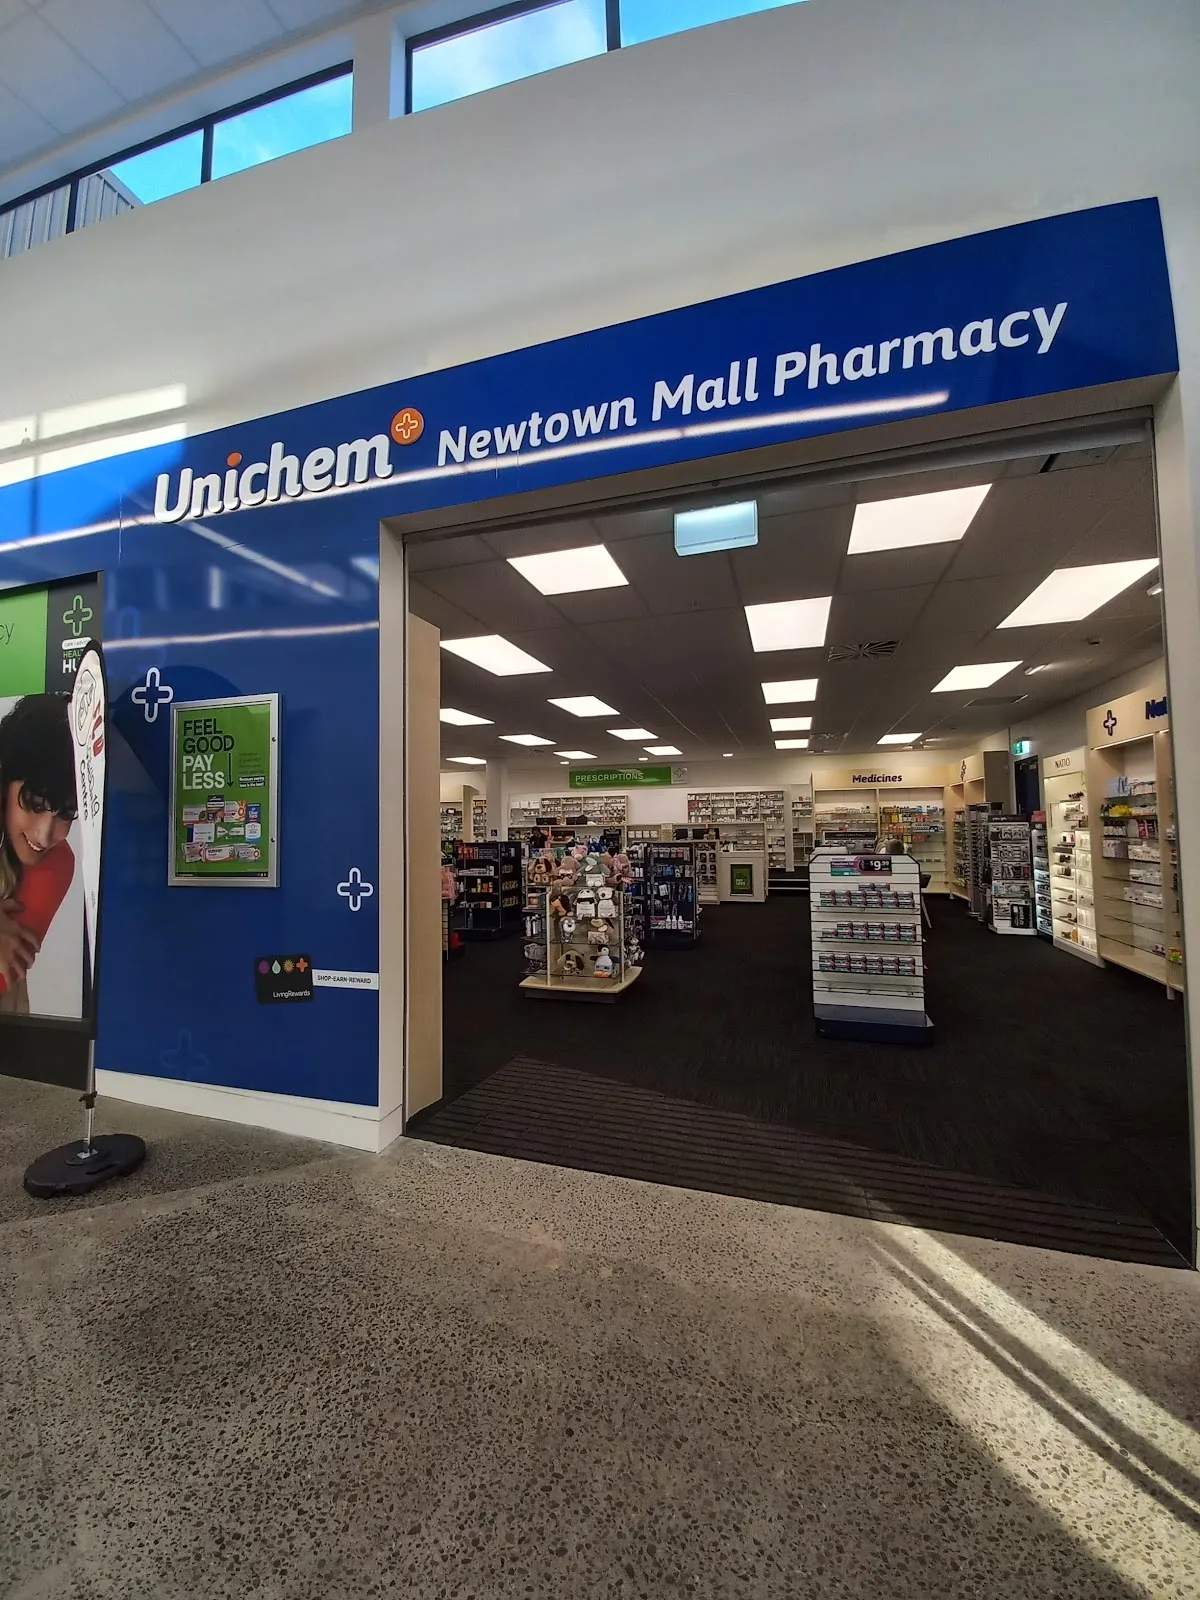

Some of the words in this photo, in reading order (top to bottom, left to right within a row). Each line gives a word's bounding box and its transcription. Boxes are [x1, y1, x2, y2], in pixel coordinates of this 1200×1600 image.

[154, 434, 393, 523] Unichem
[437, 396, 637, 467] Newtown
[652, 357, 758, 421] Mall
[774, 302, 1068, 397] Pharmacy
[63, 649, 84, 659] HEAL
[183, 718, 223, 737] FEEL
[183, 735, 235, 754] GOOD
[183, 754, 214, 772] PAY
[183, 771, 225, 790] LESS
[575, 772, 644, 782] PRESCRIPTIONS
[852, 774, 903, 784] Medicines
[273, 990, 311, 999] LivingRewards
